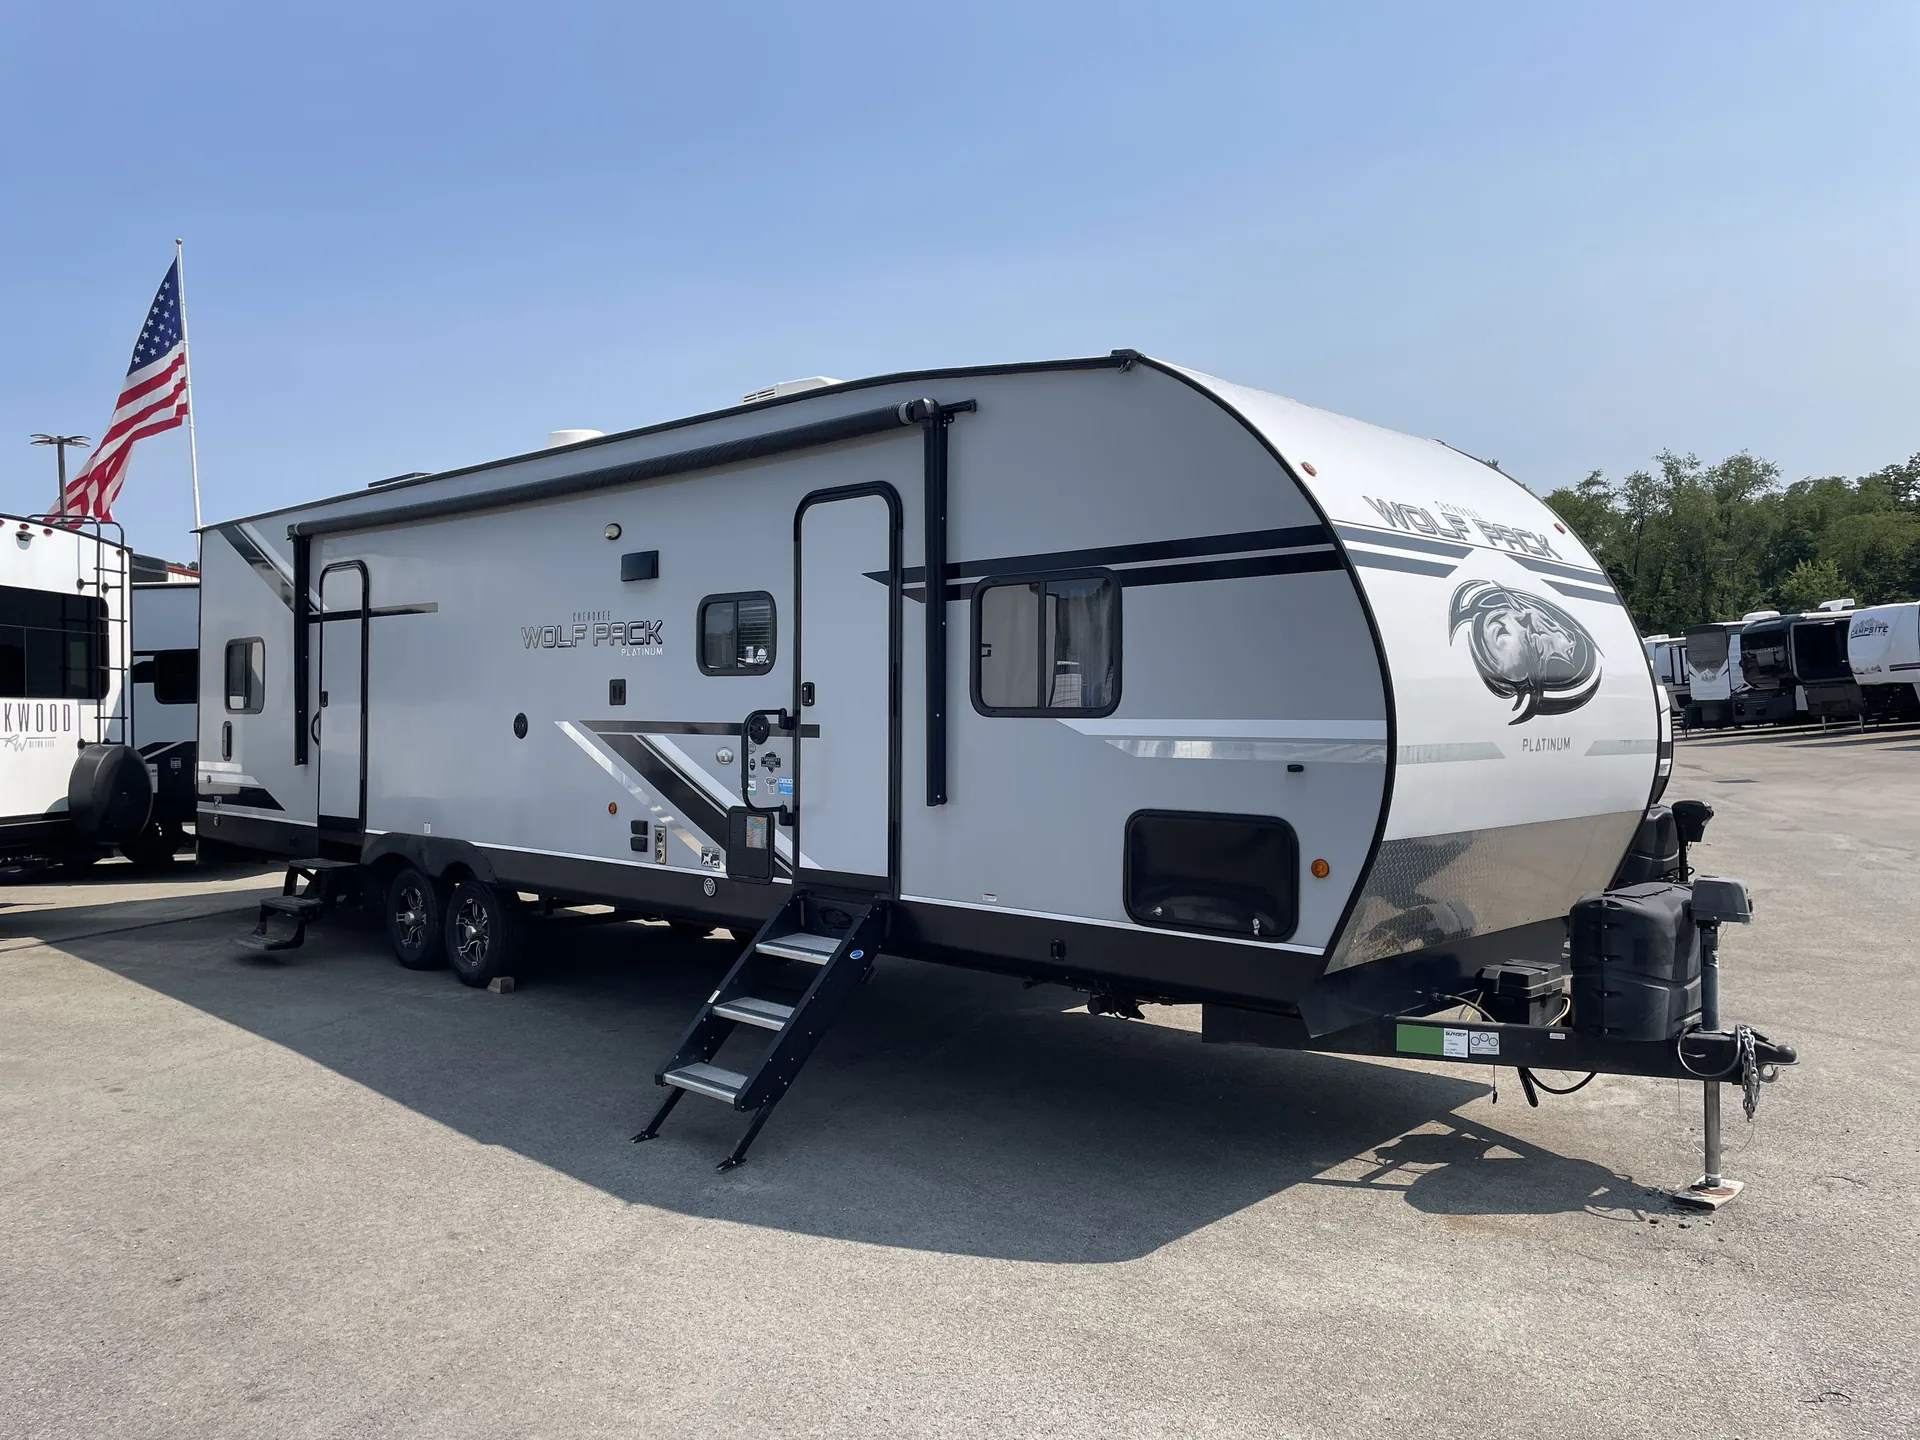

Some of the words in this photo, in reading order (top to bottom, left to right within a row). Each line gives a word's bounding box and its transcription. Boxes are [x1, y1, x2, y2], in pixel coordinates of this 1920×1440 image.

[1362, 495, 1471, 541] WOLF
[1472, 518, 1563, 561] PACK
[573, 610, 612, 622] CHEROKEE
[521, 624, 587, 649] WOLF
[594, 620, 663, 647] PACK
[1850, 625, 1889, 637] CAMPSITE
[621, 647, 664, 657] PLATINUM
[1522, 737, 1571, 752] PLATINUM
